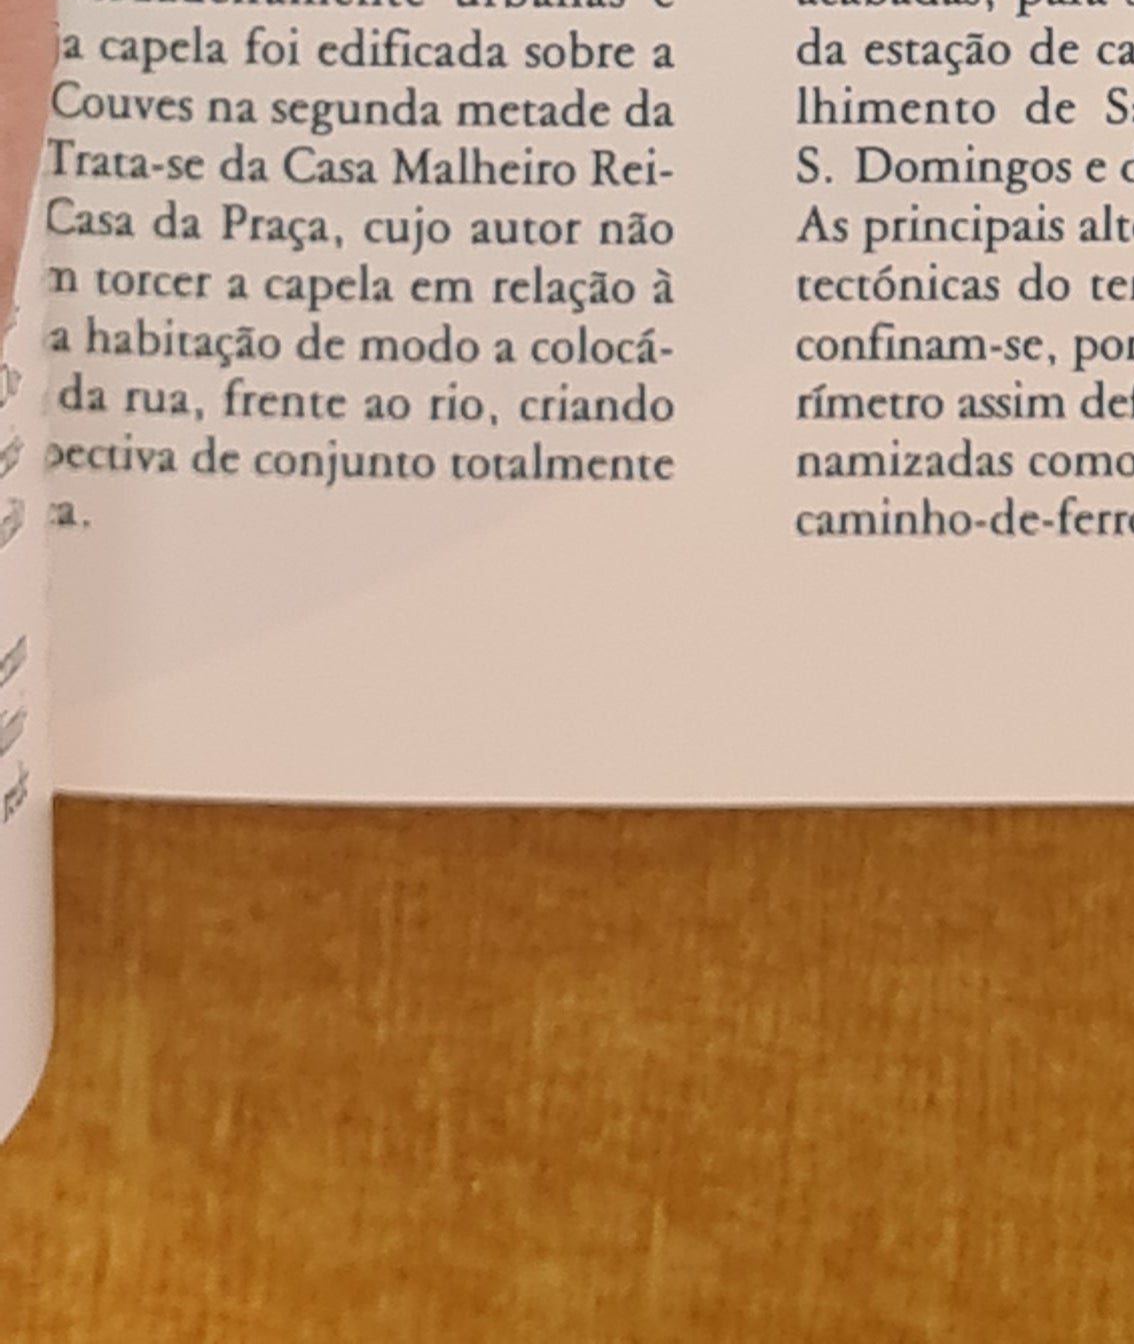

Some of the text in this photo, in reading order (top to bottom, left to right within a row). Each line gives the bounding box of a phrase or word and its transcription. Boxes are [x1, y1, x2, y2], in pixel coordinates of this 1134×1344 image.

[51, 79, 675, 137] Couves na segunda metade da
[796, 84, 996, 126] lhimento
[1024, 84, 1077, 126] de
[47, 137, 674, 188] Trata-se da Casa Malheiro Rei-
[796, 145, 833, 185] S.
[855, 143, 1073, 196] Domingos
[1085, 157, 1107, 184] e
[94, 268, 213, 300] torcer
[227, 273, 250, 301] a
[263, 262, 395, 313] capela
[409, 277, 474, 304] em
[492, 264, 636, 316] relação
[652, 267, 675, 305] à
[796, 261, 1001, 303] tectónicas
[1017, 260, 1071, 302] do
[85, 315, 282, 369] habitação
[295, 320, 346, 362] de
[358, 322, 481, 364] modo
[494, 337, 517, 365] a
[530, 324, 674, 365] colocá-
[795, 320, 1057, 367] confinam-se,
[191, 434, 241, 476] de
[253, 438, 436, 488] conjunto
[450, 440, 675, 482] totalmente
[796, 436, 1014, 479] namizadas
